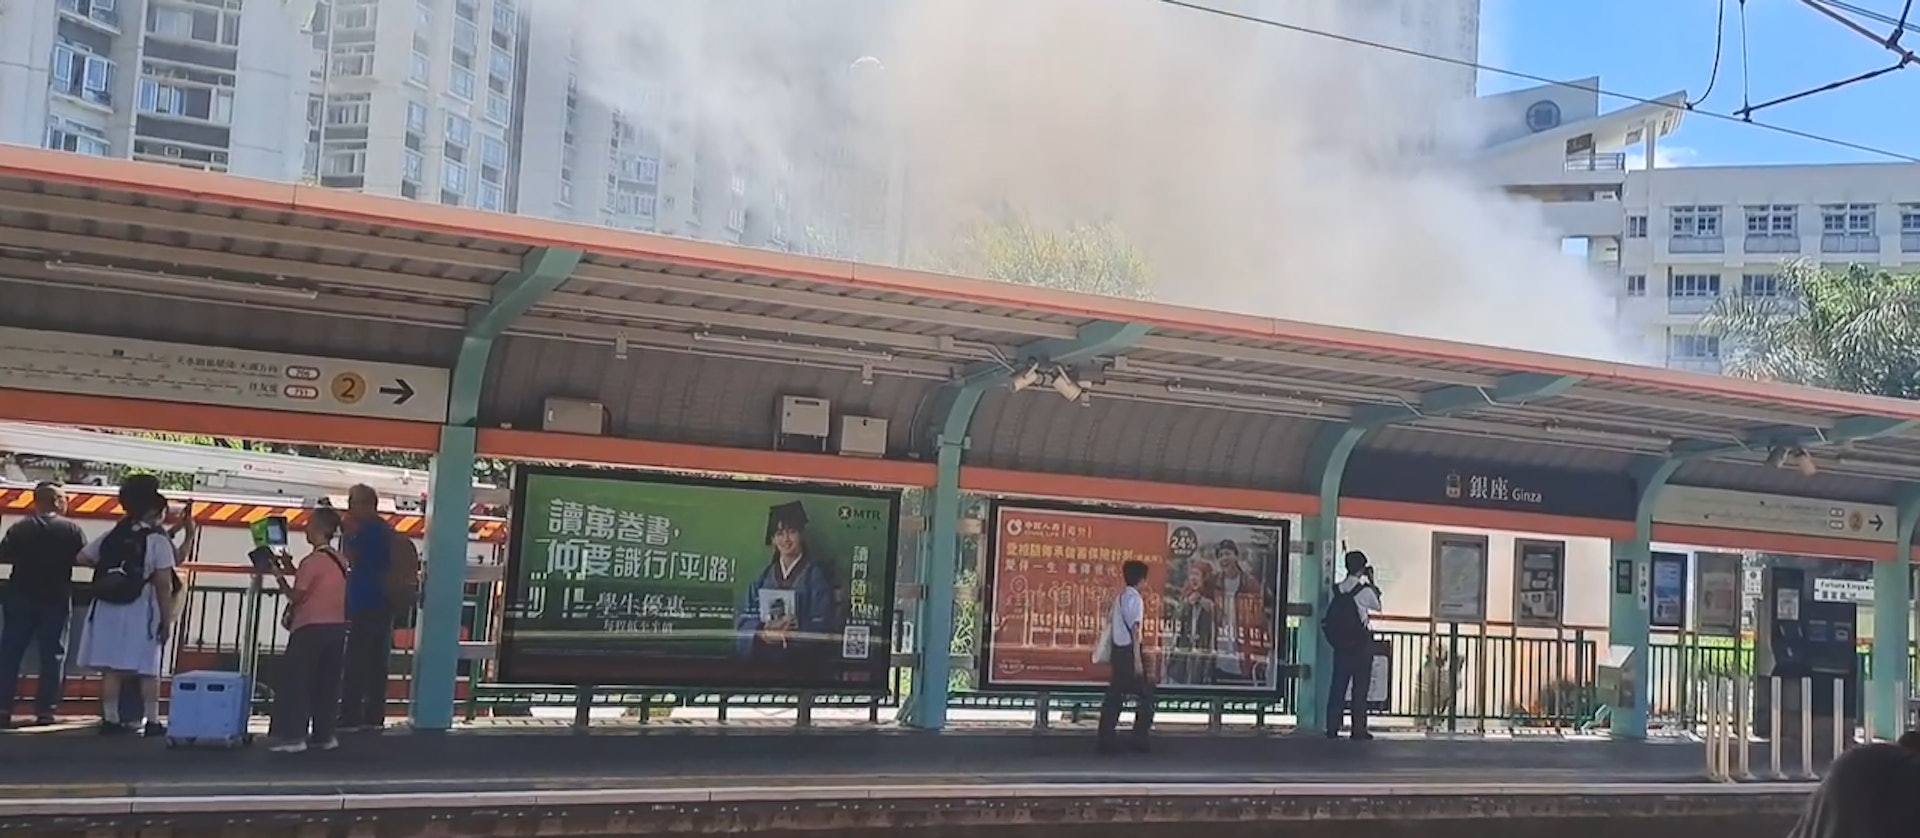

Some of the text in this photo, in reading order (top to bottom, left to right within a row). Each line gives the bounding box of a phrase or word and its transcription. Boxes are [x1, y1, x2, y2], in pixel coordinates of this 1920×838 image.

[340, 377, 356, 399] 2
[1469, 475, 1542, 503] 銀座 Ginza
[853, 508, 881, 521] MTR
[1170, 536, 1196, 550] 24%
